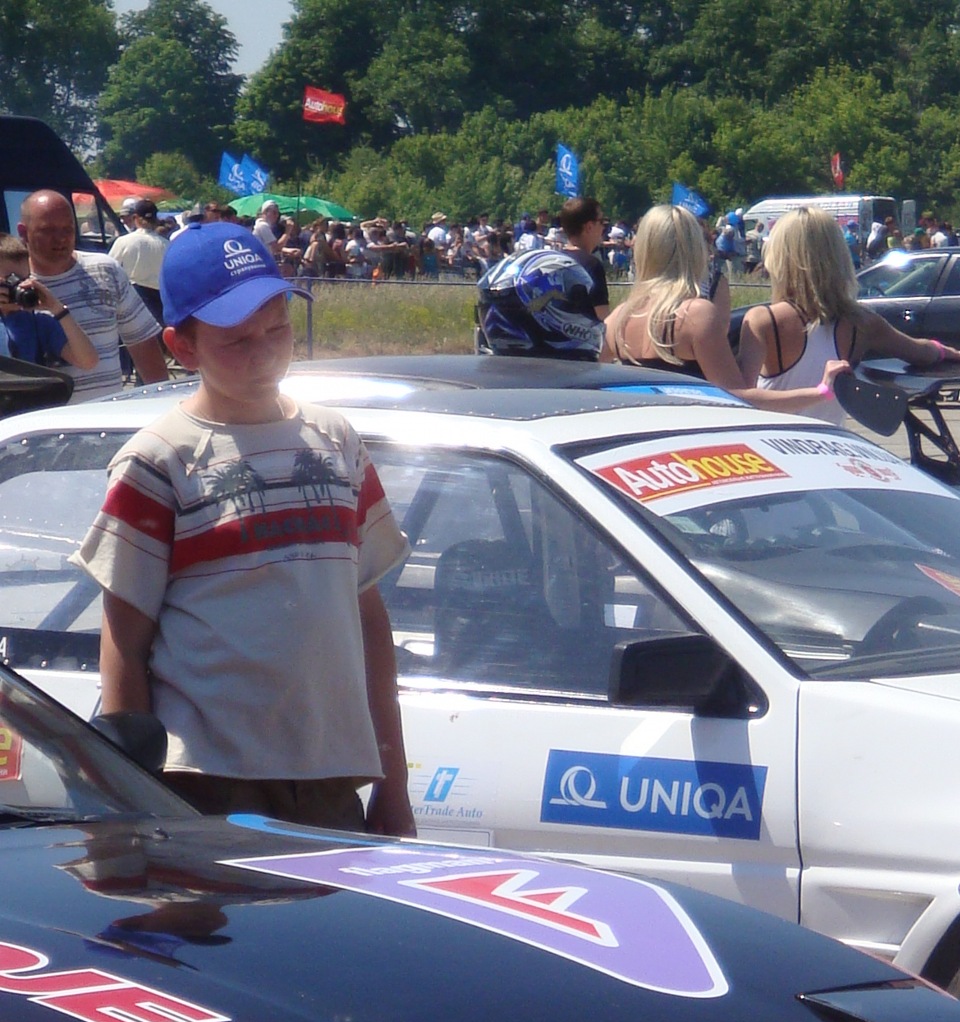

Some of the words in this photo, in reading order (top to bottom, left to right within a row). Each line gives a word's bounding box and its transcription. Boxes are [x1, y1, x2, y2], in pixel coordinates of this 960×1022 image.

[223, 253, 264, 270] UNIQA
[612, 452, 776, 495] Autohouse
[456, 806, 483, 818] Auto
[619, 776, 753, 821] UNIQA
